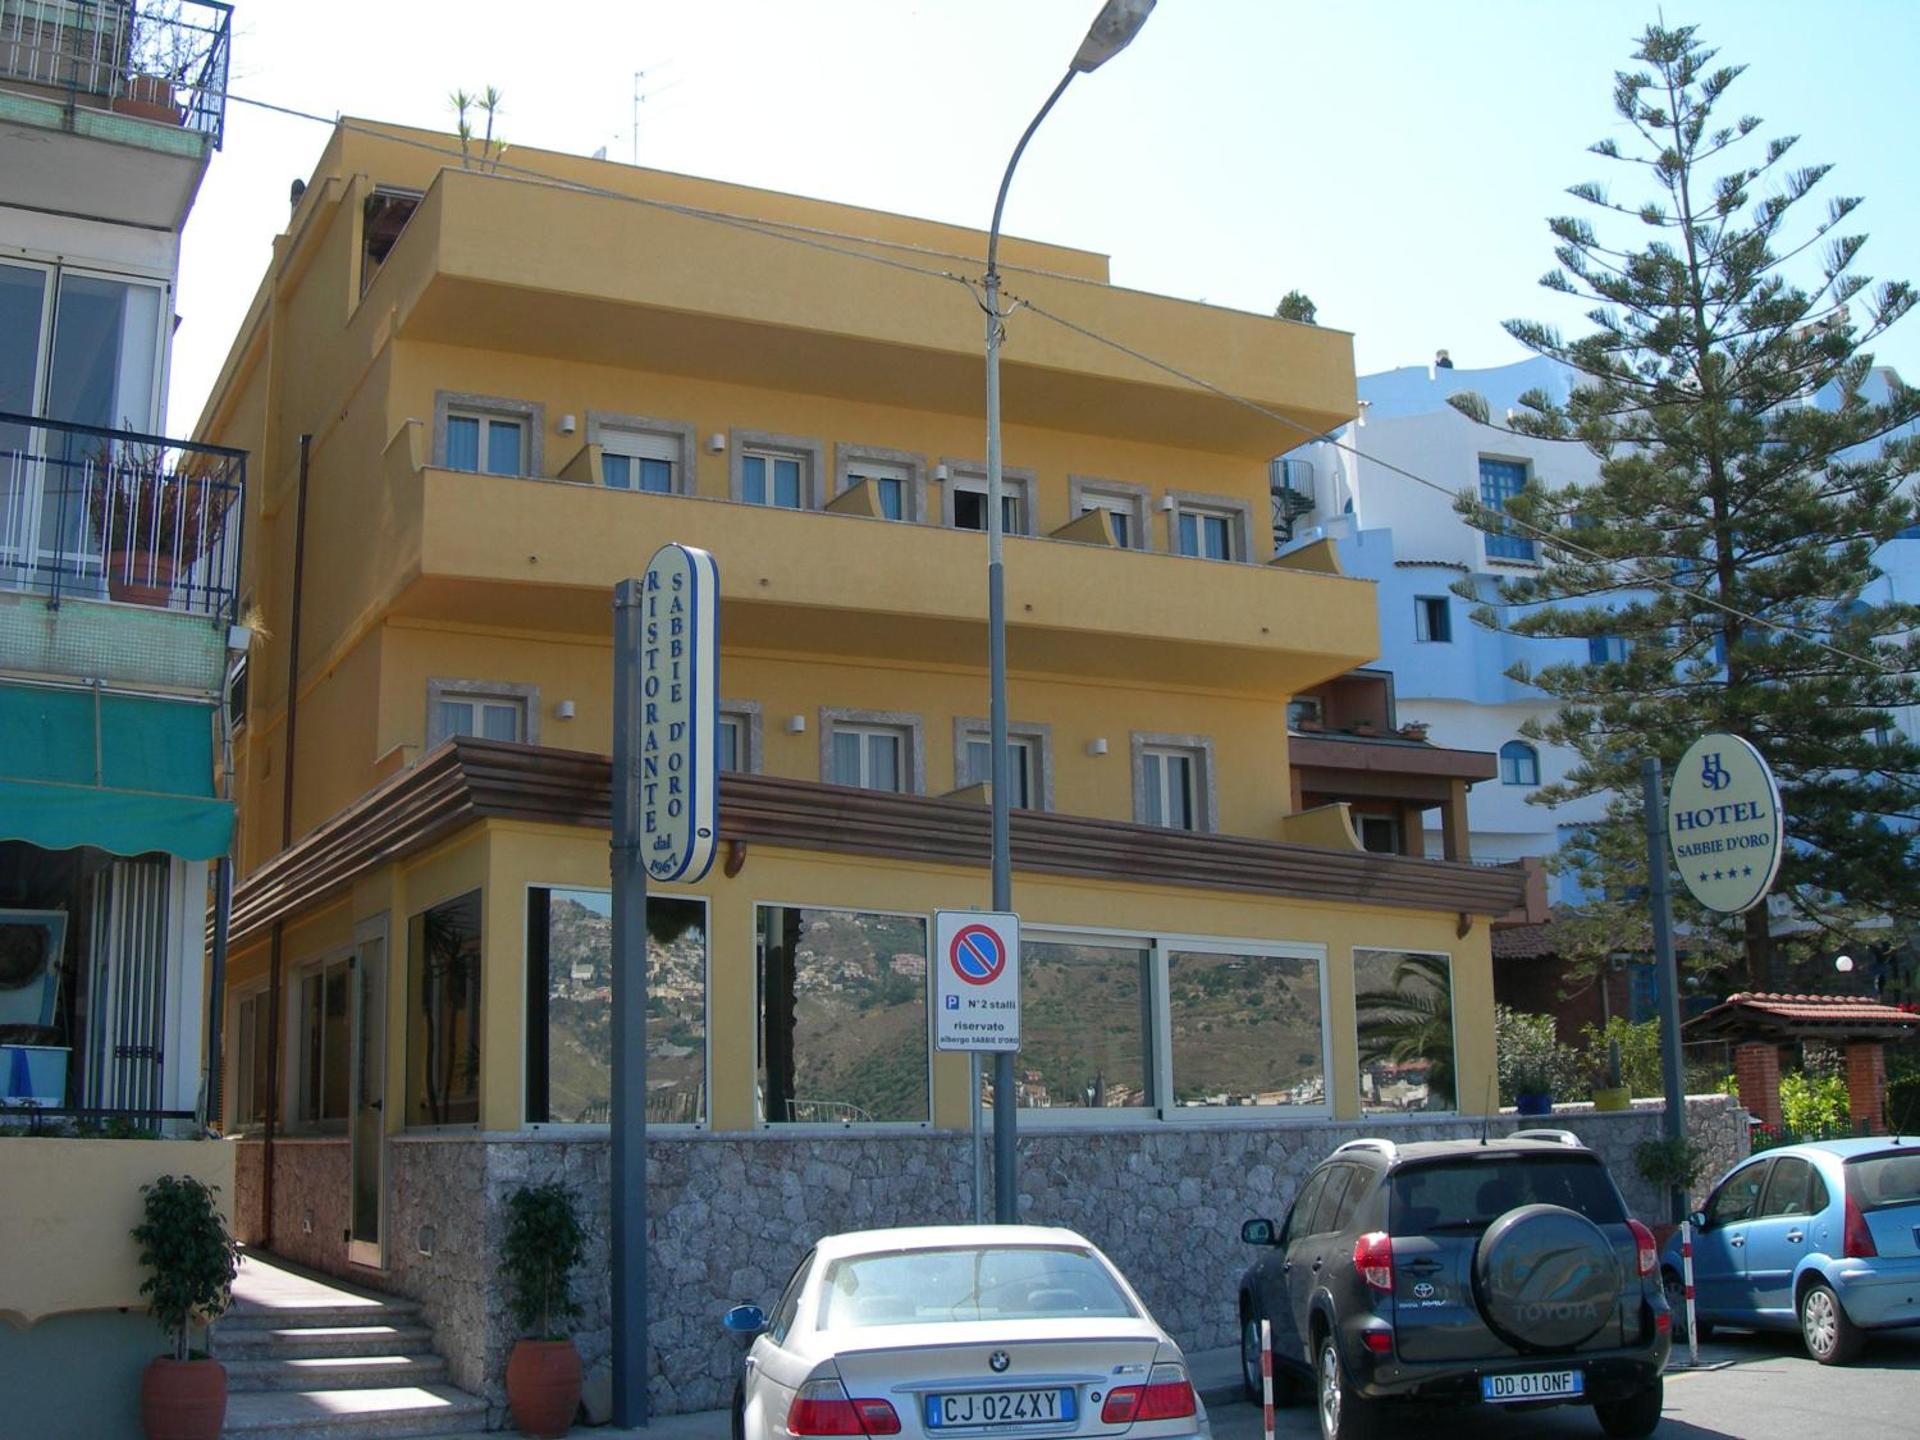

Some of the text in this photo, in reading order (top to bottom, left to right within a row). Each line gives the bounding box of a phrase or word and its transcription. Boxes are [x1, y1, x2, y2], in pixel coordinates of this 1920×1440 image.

[669, 572, 684, 703] SABBIE
[645, 570, 660, 833] RISTORANTE
[1674, 801, 1766, 831] HOTEL
[653, 833, 672, 851] dal
[1677, 833, 1770, 858] SABBIE D'ORO
[650, 852, 679, 875] 1967
[989, 1000, 1016, 1010] stalli
[954, 1021, 1005, 1032] riservato
[940, 1035, 970, 1045] albergo
[1512, 1302, 1598, 1322] TOYOTA
